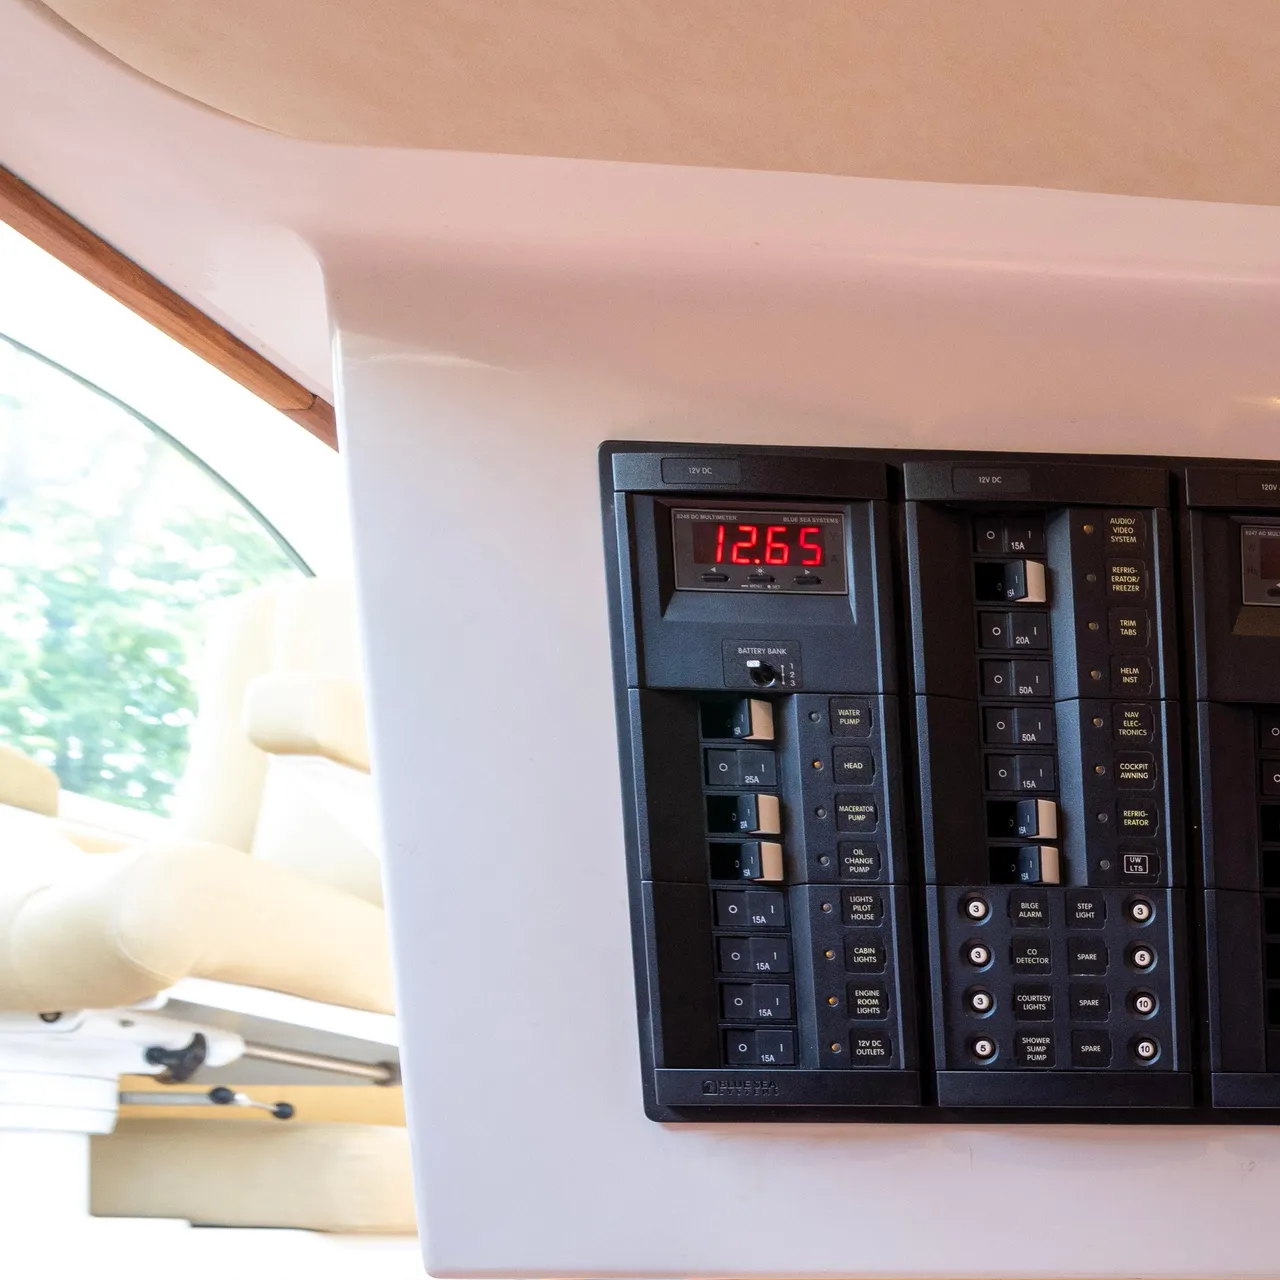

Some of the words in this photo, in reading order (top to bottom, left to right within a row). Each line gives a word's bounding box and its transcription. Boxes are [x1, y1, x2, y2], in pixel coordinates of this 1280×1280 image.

[689, 467, 700, 475] 12V
[702, 467, 712, 475] DC
[978, 476, 989, 484] 12V
[990, 476, 1002, 484] DC
[1261, 483, 1277, 491] 120V
[1109, 517, 1136, 525] AUDIO/
[1112, 526, 1134, 534] VIDEO
[1110, 535, 1137, 543] SYSTEM
[715, 524, 822, 566] 12.65
[1011, 541, 1025, 550] 15A
[1112, 566, 1139, 574] REFRIG-
[1111, 575, 1140, 583] ERATOR/
[1112, 584, 1140, 592] FREEZER
[1119, 619, 1137, 627] TRIM
[1120, 628, 1137, 636] TABS
[1015, 636, 1030, 645] 20A
[738, 647, 766, 655] BATTERY
[767, 647, 787, 655] BANK
[1120, 667, 1140, 675] HELM
[1122, 675, 1138, 684] INST
[1018, 686, 1033, 695] 50A
[838, 709, 860, 717] WATER
[839, 718, 860, 726] PUMP
[844, 762, 863, 770] HEAD
[838, 805, 874, 813] MACERATOR
[1123, 810, 1149, 818] REFRIG-
[1123, 818, 1150, 826] ERATOR
[844, 857, 873, 865] CHANGE
[849, 866, 870, 874] PUMP
[1129, 864, 1144, 872] LTS
[852, 904, 872, 912] PILOT
[851, 913, 874, 921] HOUSE
[1018, 910, 1042, 918] ALARM
[1075, 911, 1095, 919] LIGHT
[751, 916, 767, 924] 15A
[853, 956, 877, 964] LIGHTS
[857, 998, 879, 1006] ROOM
[1017, 994, 1052, 1002] COURTESY
[1138, 1000, 1149, 1008] 10
[1021, 1036, 1051, 1044] SHOWER
[856, 1048, 885, 1056] OUTLETS
[1140, 1045, 1150, 1053] 10
[1026, 1053, 1047, 1061] PUMP
